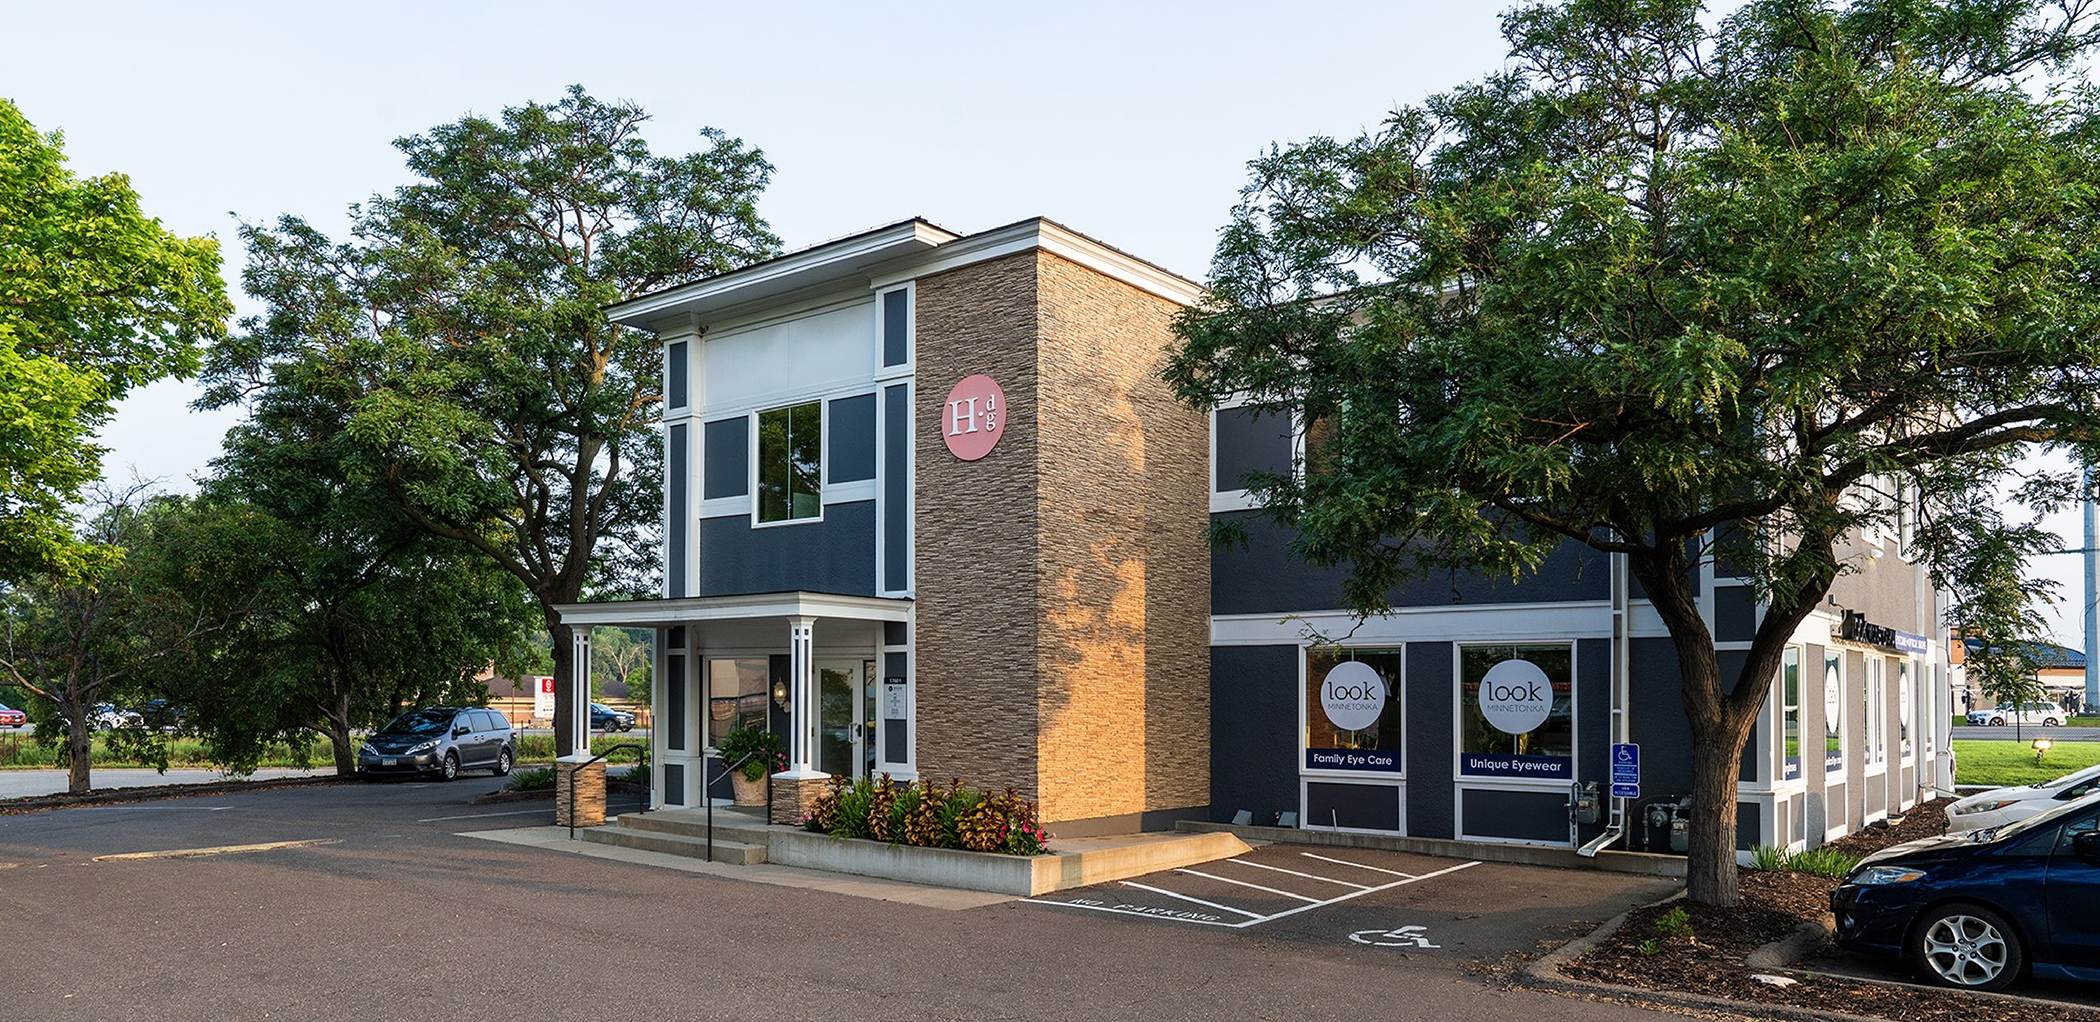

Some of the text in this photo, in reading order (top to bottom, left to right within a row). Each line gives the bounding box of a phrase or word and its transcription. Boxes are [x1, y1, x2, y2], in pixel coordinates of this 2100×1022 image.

[1327, 681, 1377, 700] look
[1486, 681, 1543, 701] look
[1327, 703, 1379, 711] MINNETONKA
[1486, 704, 1546, 713] MINNETONKA
[1313, 753, 1393, 766] Family Eye Care
[1470, 758, 1562, 772] Unique Eyewear
[1068, 898, 1221, 921] NO PARKING
